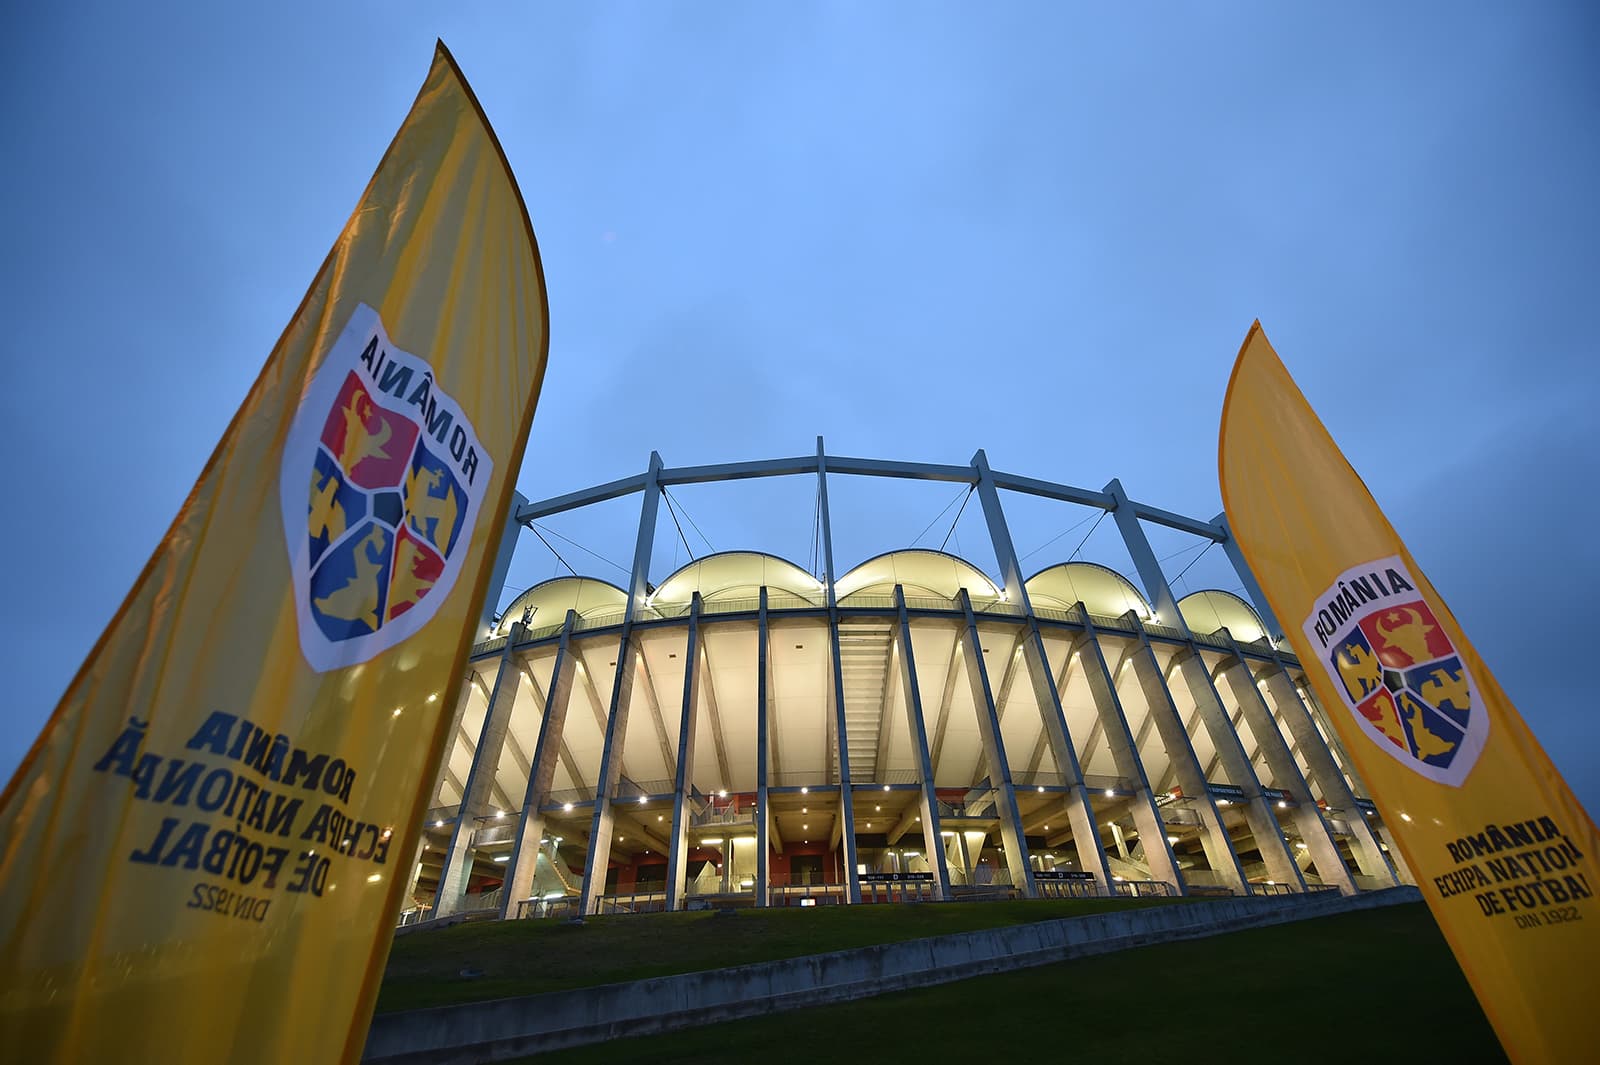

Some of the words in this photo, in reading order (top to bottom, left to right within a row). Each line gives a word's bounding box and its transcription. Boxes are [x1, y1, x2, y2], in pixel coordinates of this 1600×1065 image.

[1314, 568, 1414, 649] ROMÂNIA
[1446, 815, 1562, 864] ROMÂNIA
[1433, 864, 1493, 899] ECHIPA
[1475, 891, 1506, 917] DE
[1514, 912, 1542, 930] DIN
[1541, 906, 1583, 925] 1922
